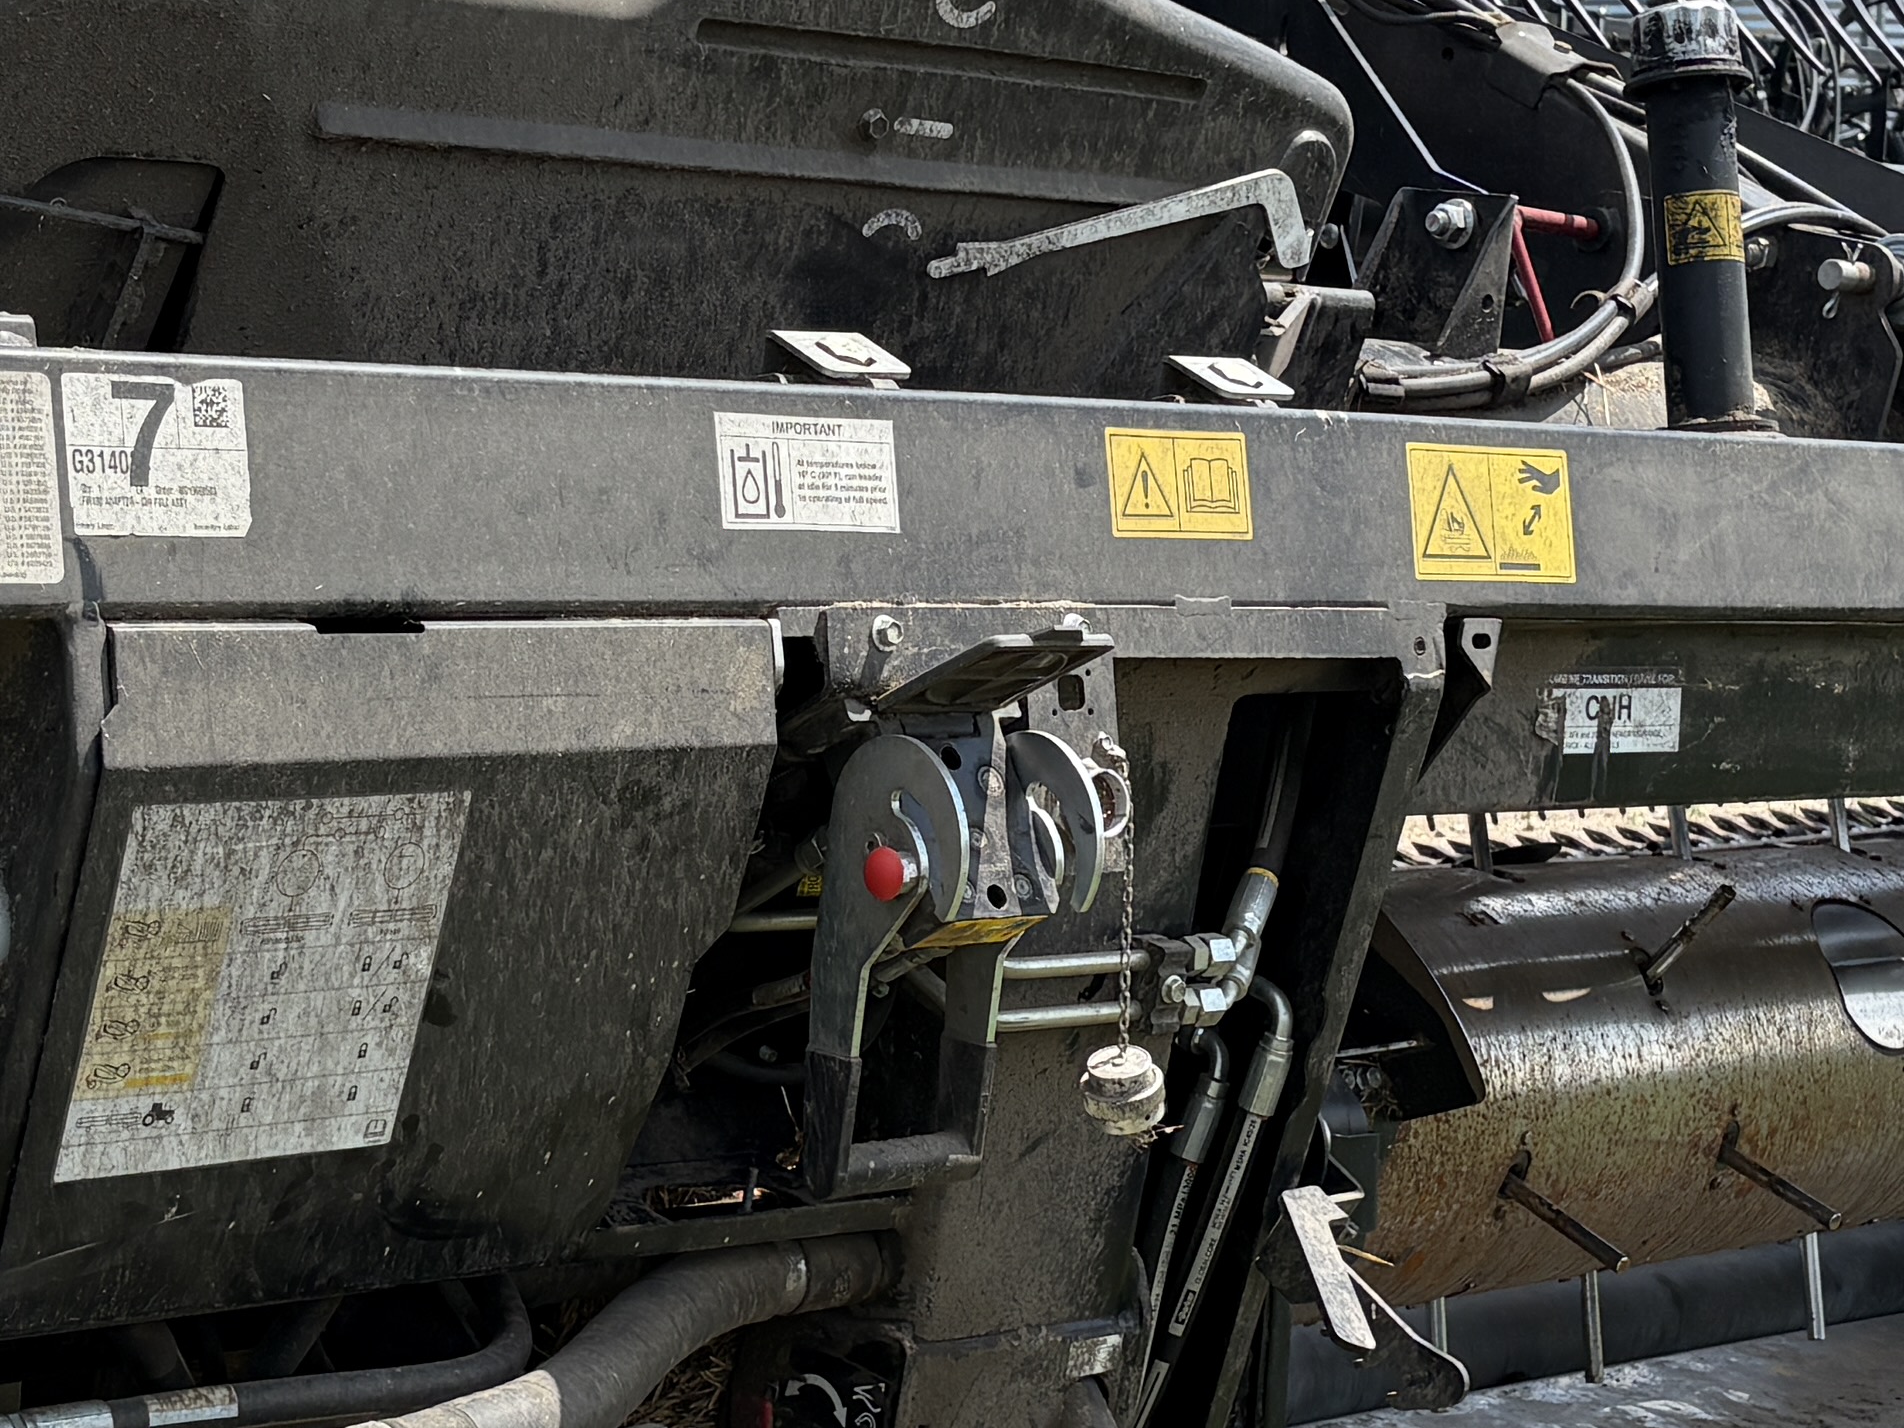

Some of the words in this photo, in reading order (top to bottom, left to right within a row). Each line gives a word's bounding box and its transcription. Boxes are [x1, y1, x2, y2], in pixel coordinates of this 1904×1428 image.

[110, 380, 176, 488] 7
[771, 421, 843, 437] IMPORTANT
[71, 448, 134, 474] G3140
